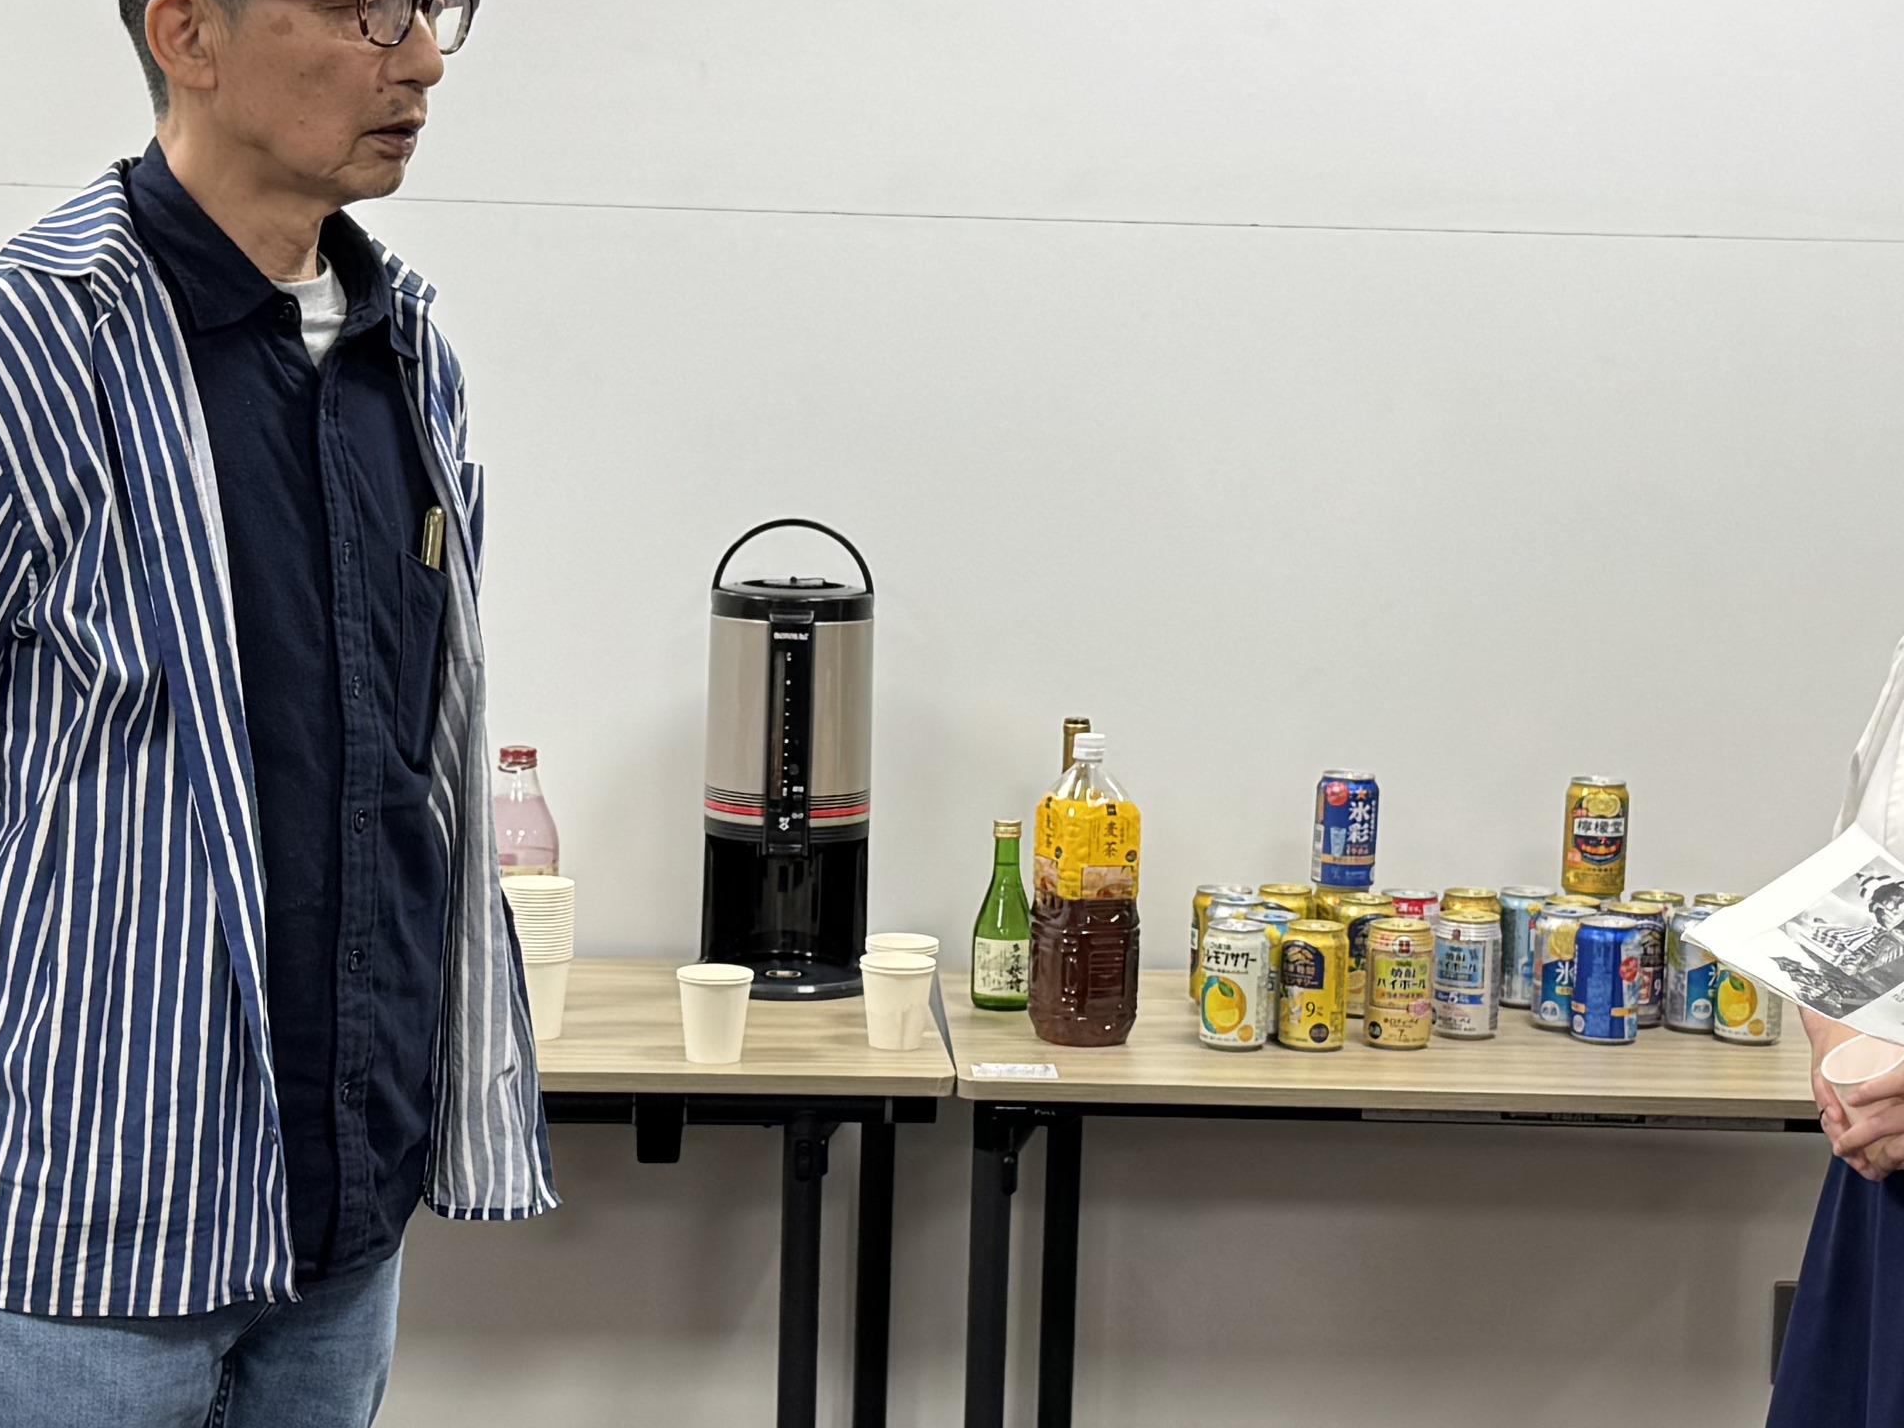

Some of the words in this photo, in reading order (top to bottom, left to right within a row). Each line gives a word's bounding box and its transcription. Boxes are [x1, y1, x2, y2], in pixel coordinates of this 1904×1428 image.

[1104, 821, 1117, 858] 麦茶
[1348, 801, 1370, 843] 氷彩
[1377, 978, 1425, 989] ハイボール
